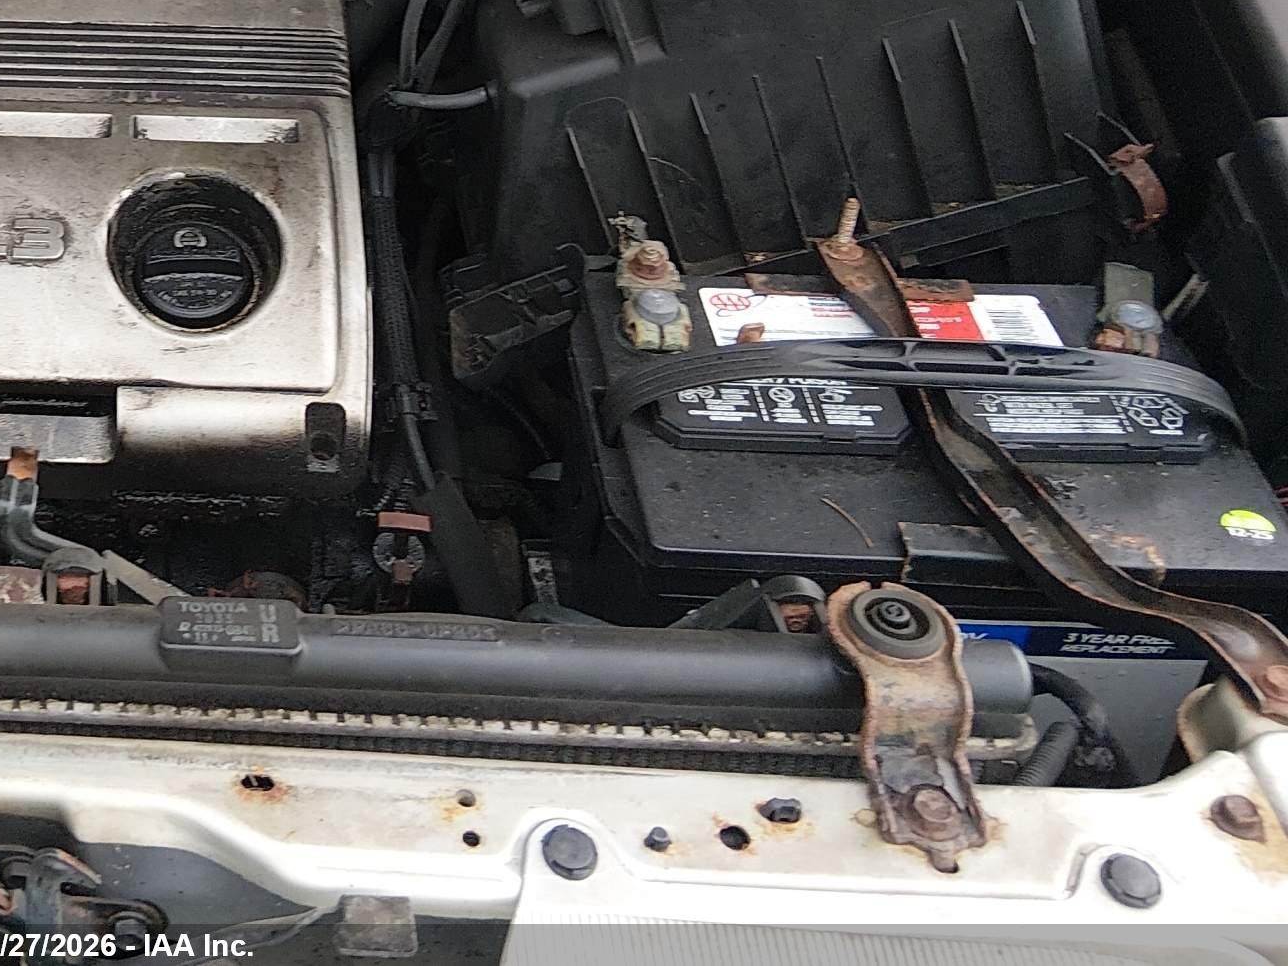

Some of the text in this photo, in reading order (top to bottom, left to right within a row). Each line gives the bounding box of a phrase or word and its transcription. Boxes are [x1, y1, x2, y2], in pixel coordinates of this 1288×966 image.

[177, 601, 249, 613] TOYOTA
[1063, 633, 1080, 643] 3
[1081, 633, 1130, 644] YEAR
[1059, 644, 1176, 654] REPLACEMENT
